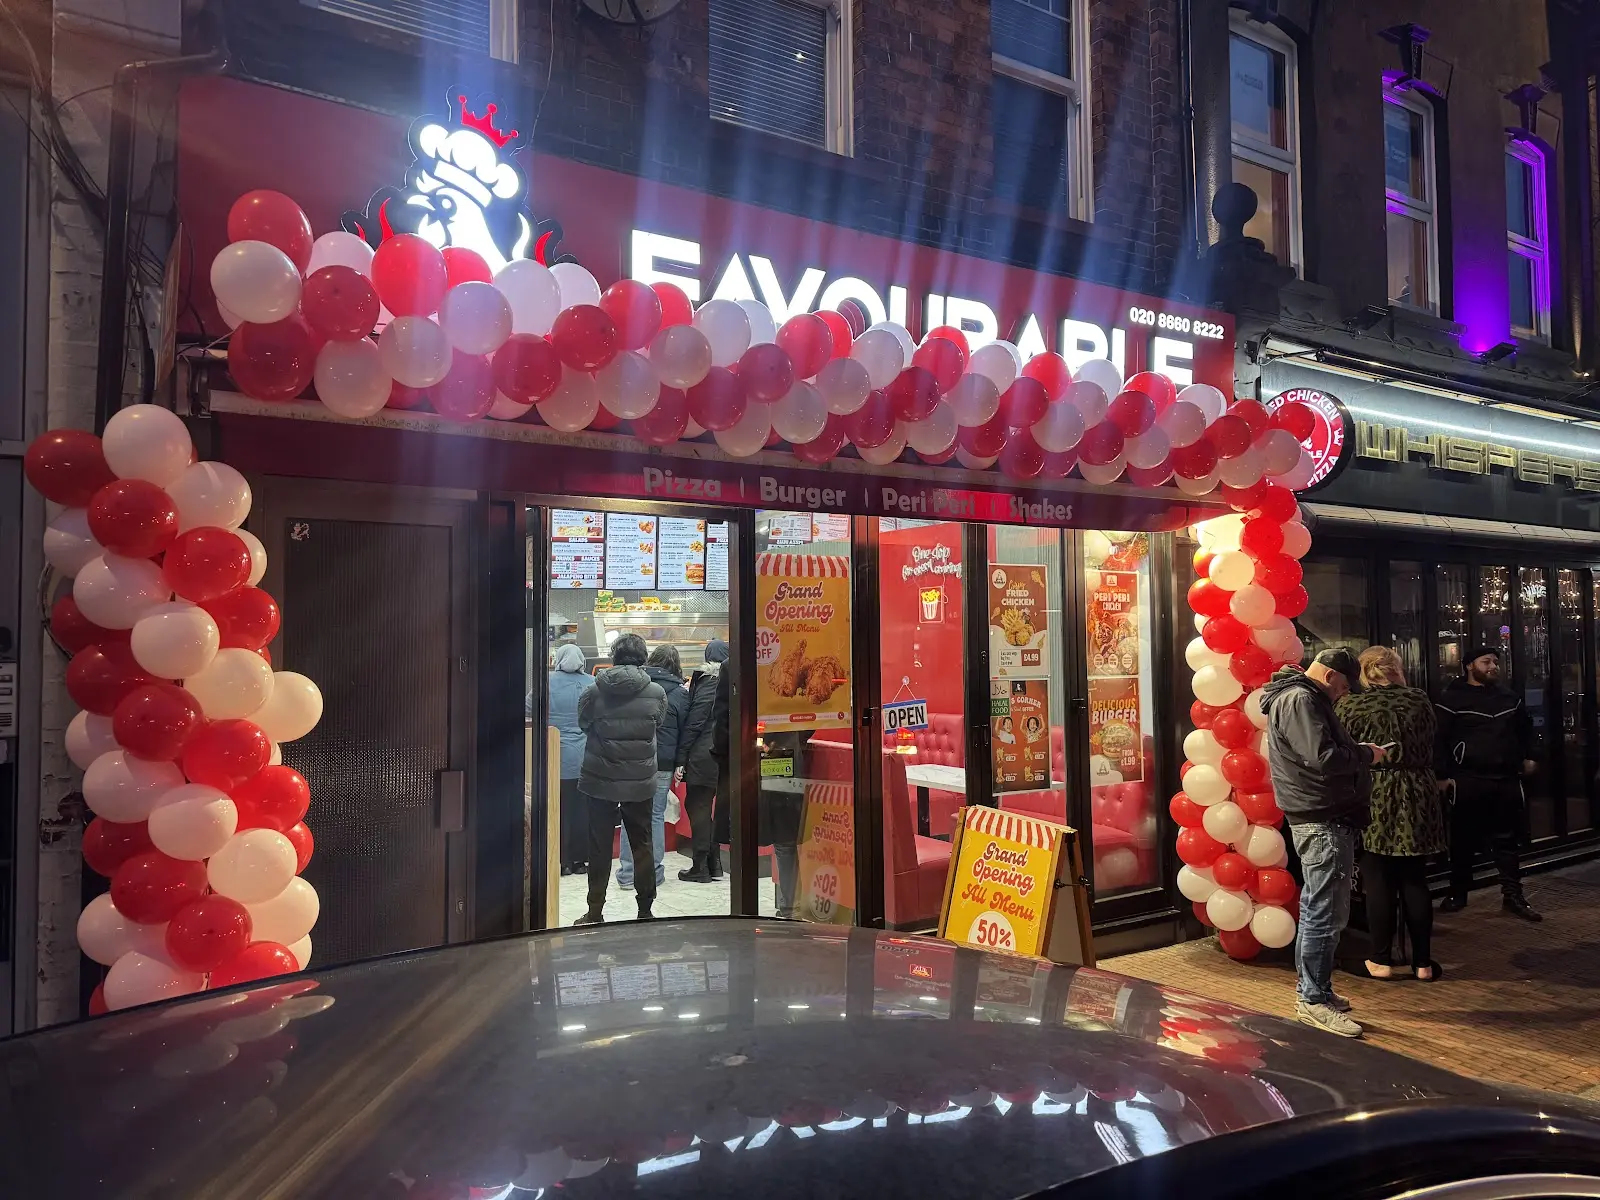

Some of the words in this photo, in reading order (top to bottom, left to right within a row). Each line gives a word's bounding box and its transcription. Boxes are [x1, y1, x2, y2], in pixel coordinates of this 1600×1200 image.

[1129, 306, 1155, 326] 020
[1158, 311, 1190, 333] 8660
[1193, 318, 1225, 340] 8222
[1287, 389, 1340, 421] CHICKEN
[643, 467, 722, 497] Pizza
[759, 476, 846, 508] Burger
[881, 487, 926, 513] Peri
[932, 488, 975, 516] Peri
[1009, 496, 1073, 521] Shakes
[774, 581, 823, 601] Grand
[1006, 589, 1029, 597] FRIED
[1094, 592, 1111, 602] PERI
[1113, 593, 1130, 603] PERI
[1001, 598, 1035, 606] CHICKEN
[765, 600, 834, 625] Opening
[780, 623, 794, 633] All
[796, 623, 820, 633] Menu
[756, 648, 772, 660] OFF
[1023, 653, 1039, 662] £4.99
[992, 683, 1008, 696] حلال
[1017, 696, 1042, 708] CORNER
[1092, 698, 1136, 712] DELICIOUS
[888, 705, 925, 728] OPEN
[991, 706, 1009, 714] FOOD
[1092, 709, 1137, 725] BURGER
[1122, 749, 1134, 757] FROM
[1121, 756, 1136, 766] £1.99
[983, 841, 1029, 867] Grand
[972, 858, 1035, 897] Opening
[961, 882, 988, 905] All
[989, 891, 1036, 922] Menu
[976, 918, 1012, 947] 50%
